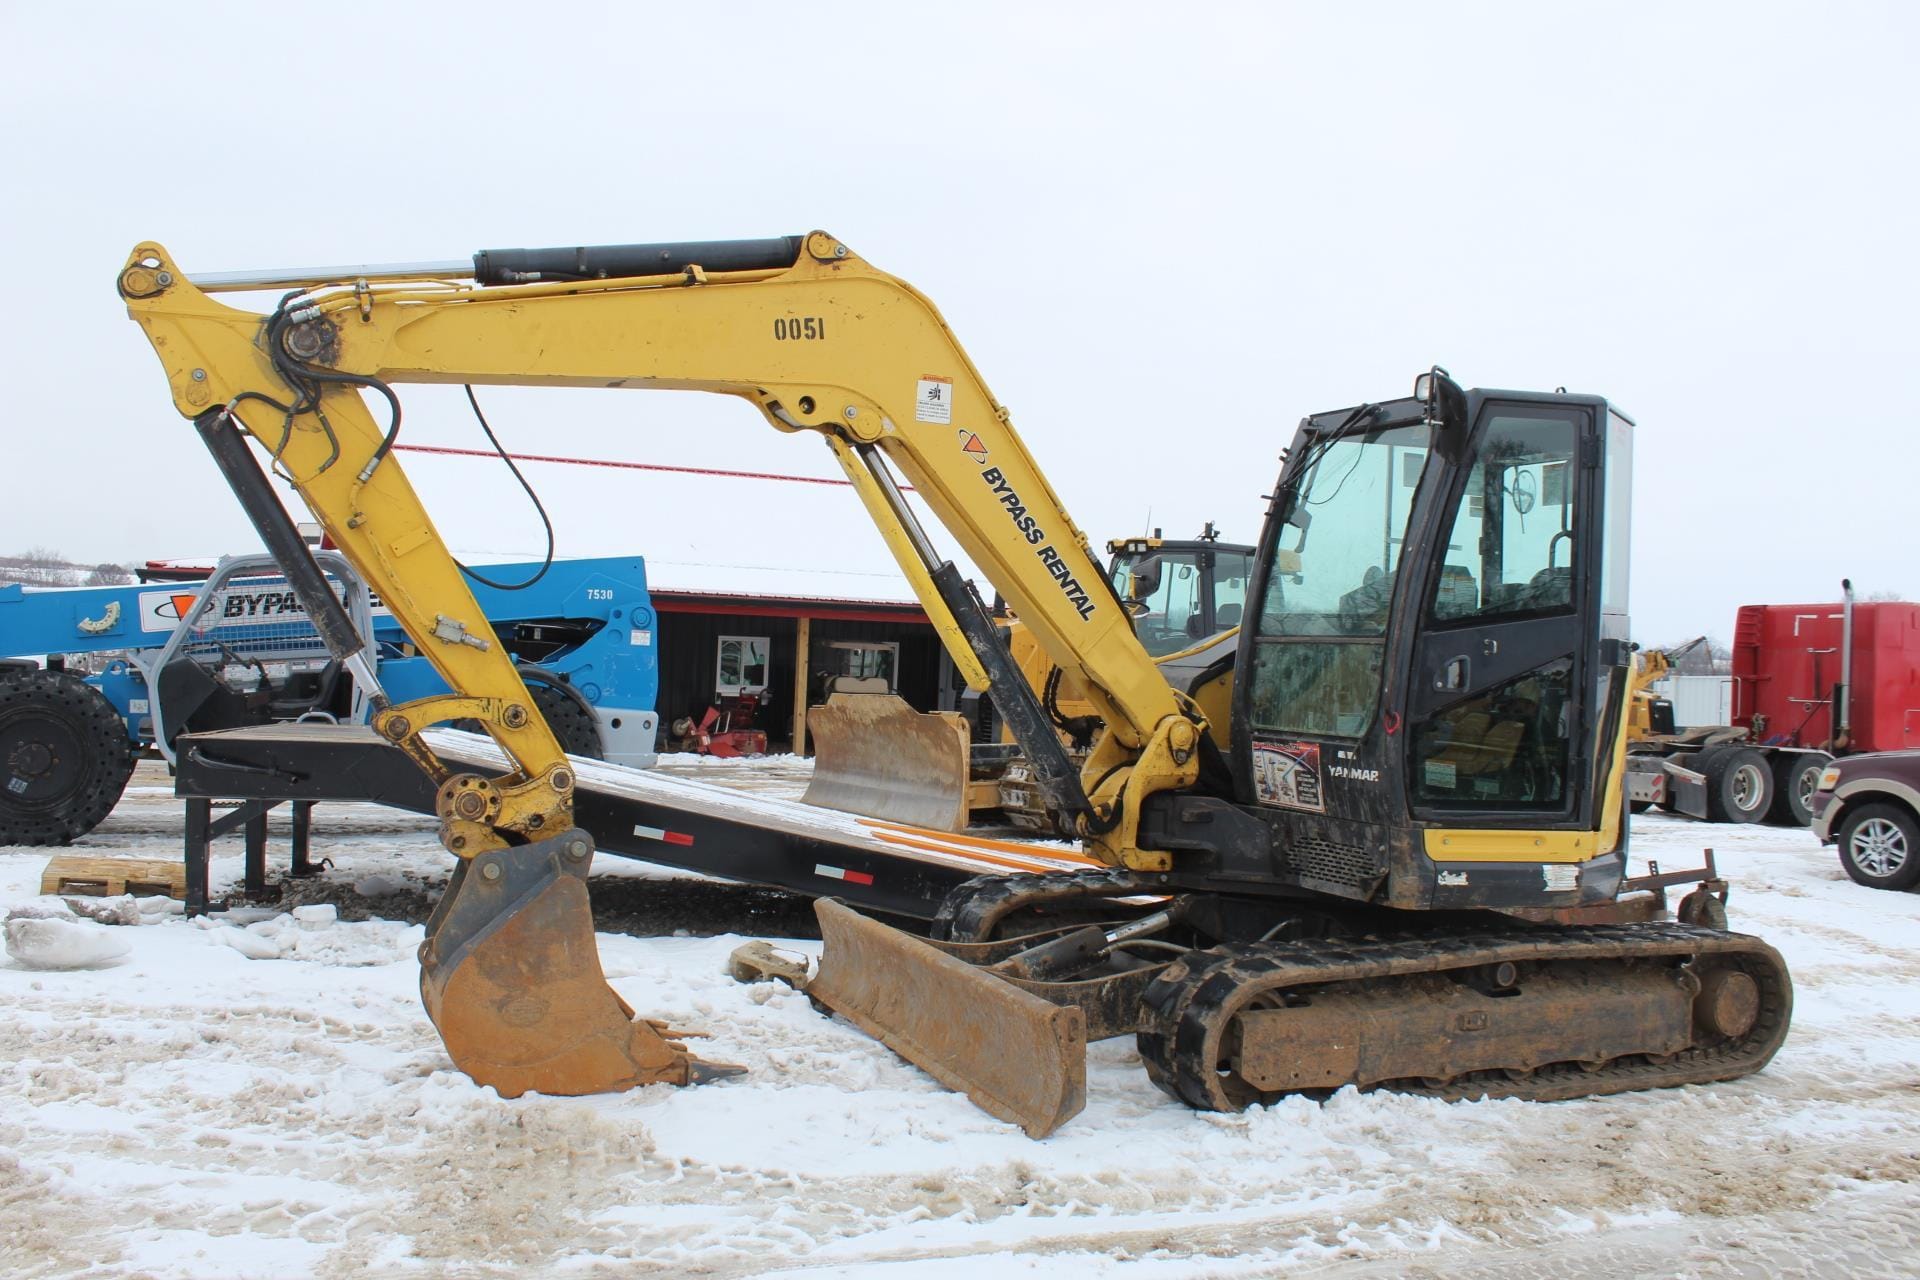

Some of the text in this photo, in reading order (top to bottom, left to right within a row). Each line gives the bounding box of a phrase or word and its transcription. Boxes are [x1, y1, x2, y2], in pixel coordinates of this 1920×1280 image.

[774, 317, 825, 341] 0051
[981, 466, 1096, 621] BYPASS RENTAL
[223, 591, 305, 618] BYPA
[587, 589, 614, 600] 7530
[1327, 765, 1380, 782] YANMAR
